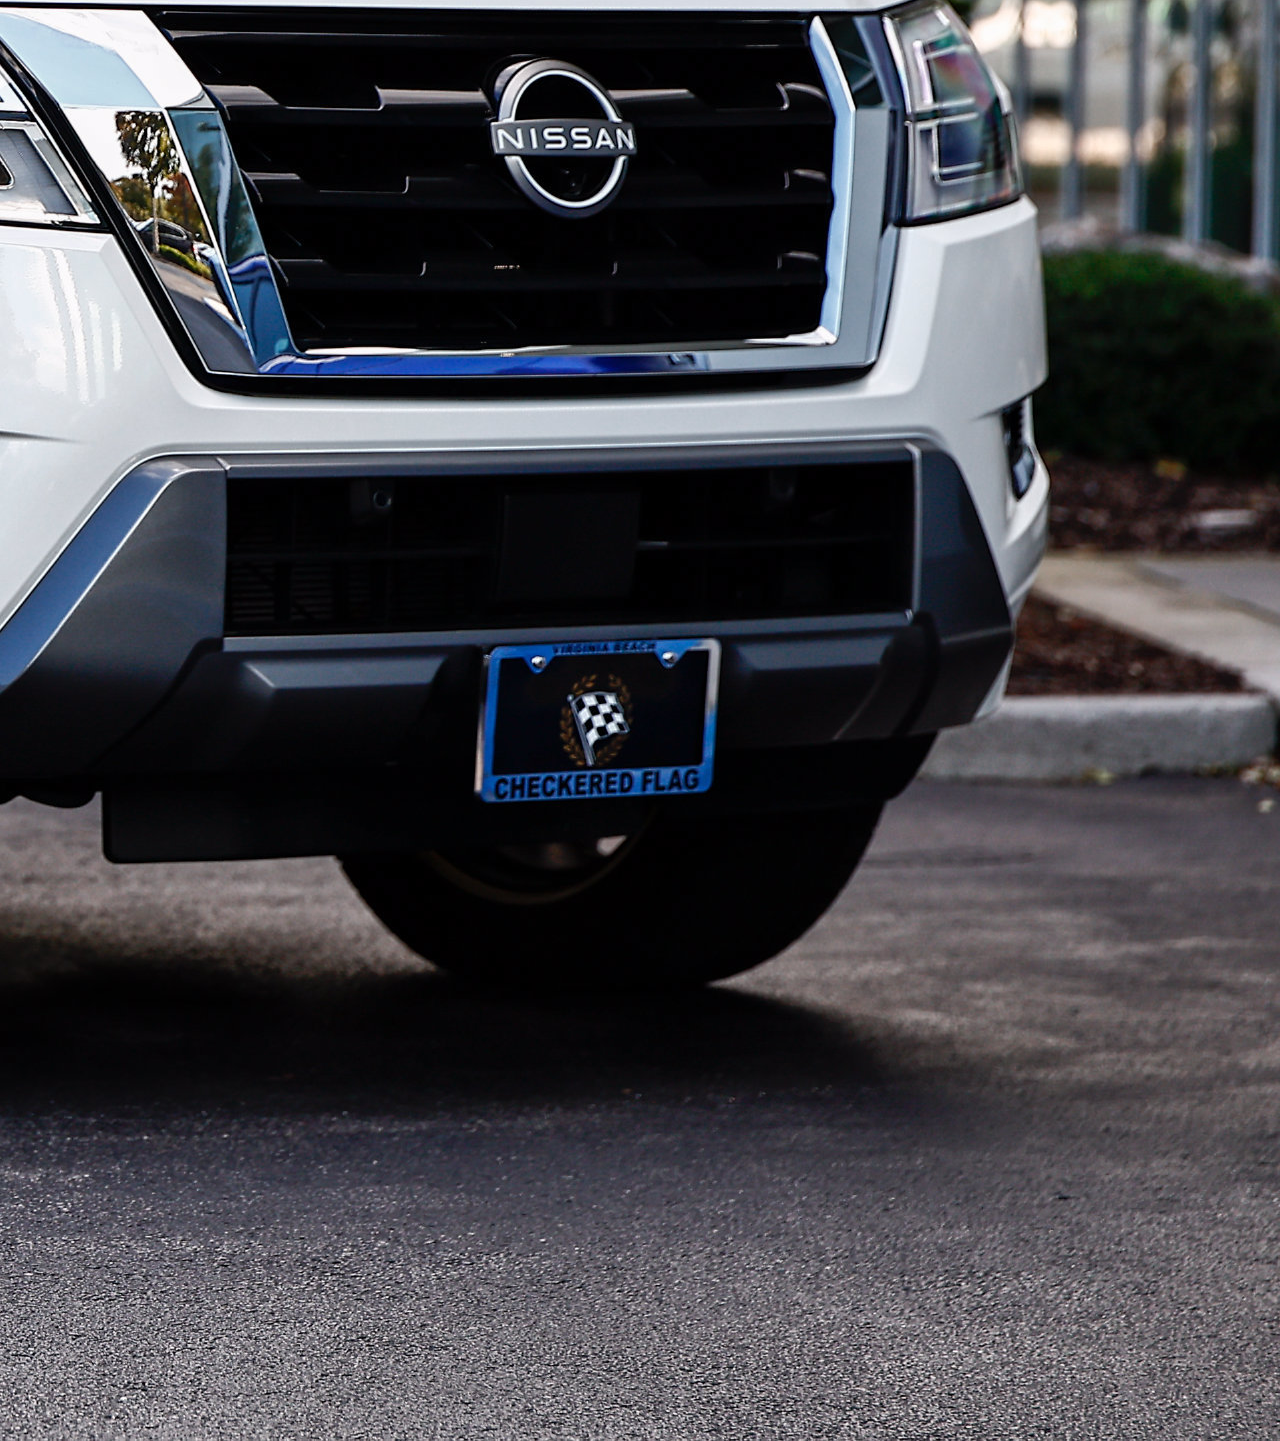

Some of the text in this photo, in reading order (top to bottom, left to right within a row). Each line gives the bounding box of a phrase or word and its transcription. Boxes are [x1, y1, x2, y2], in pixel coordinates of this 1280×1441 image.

[496, 127, 635, 151] NISSAN
[552, 640, 656, 654] VIRGINIA BEACH
[494, 768, 700, 800] CHECKERED FLAG
